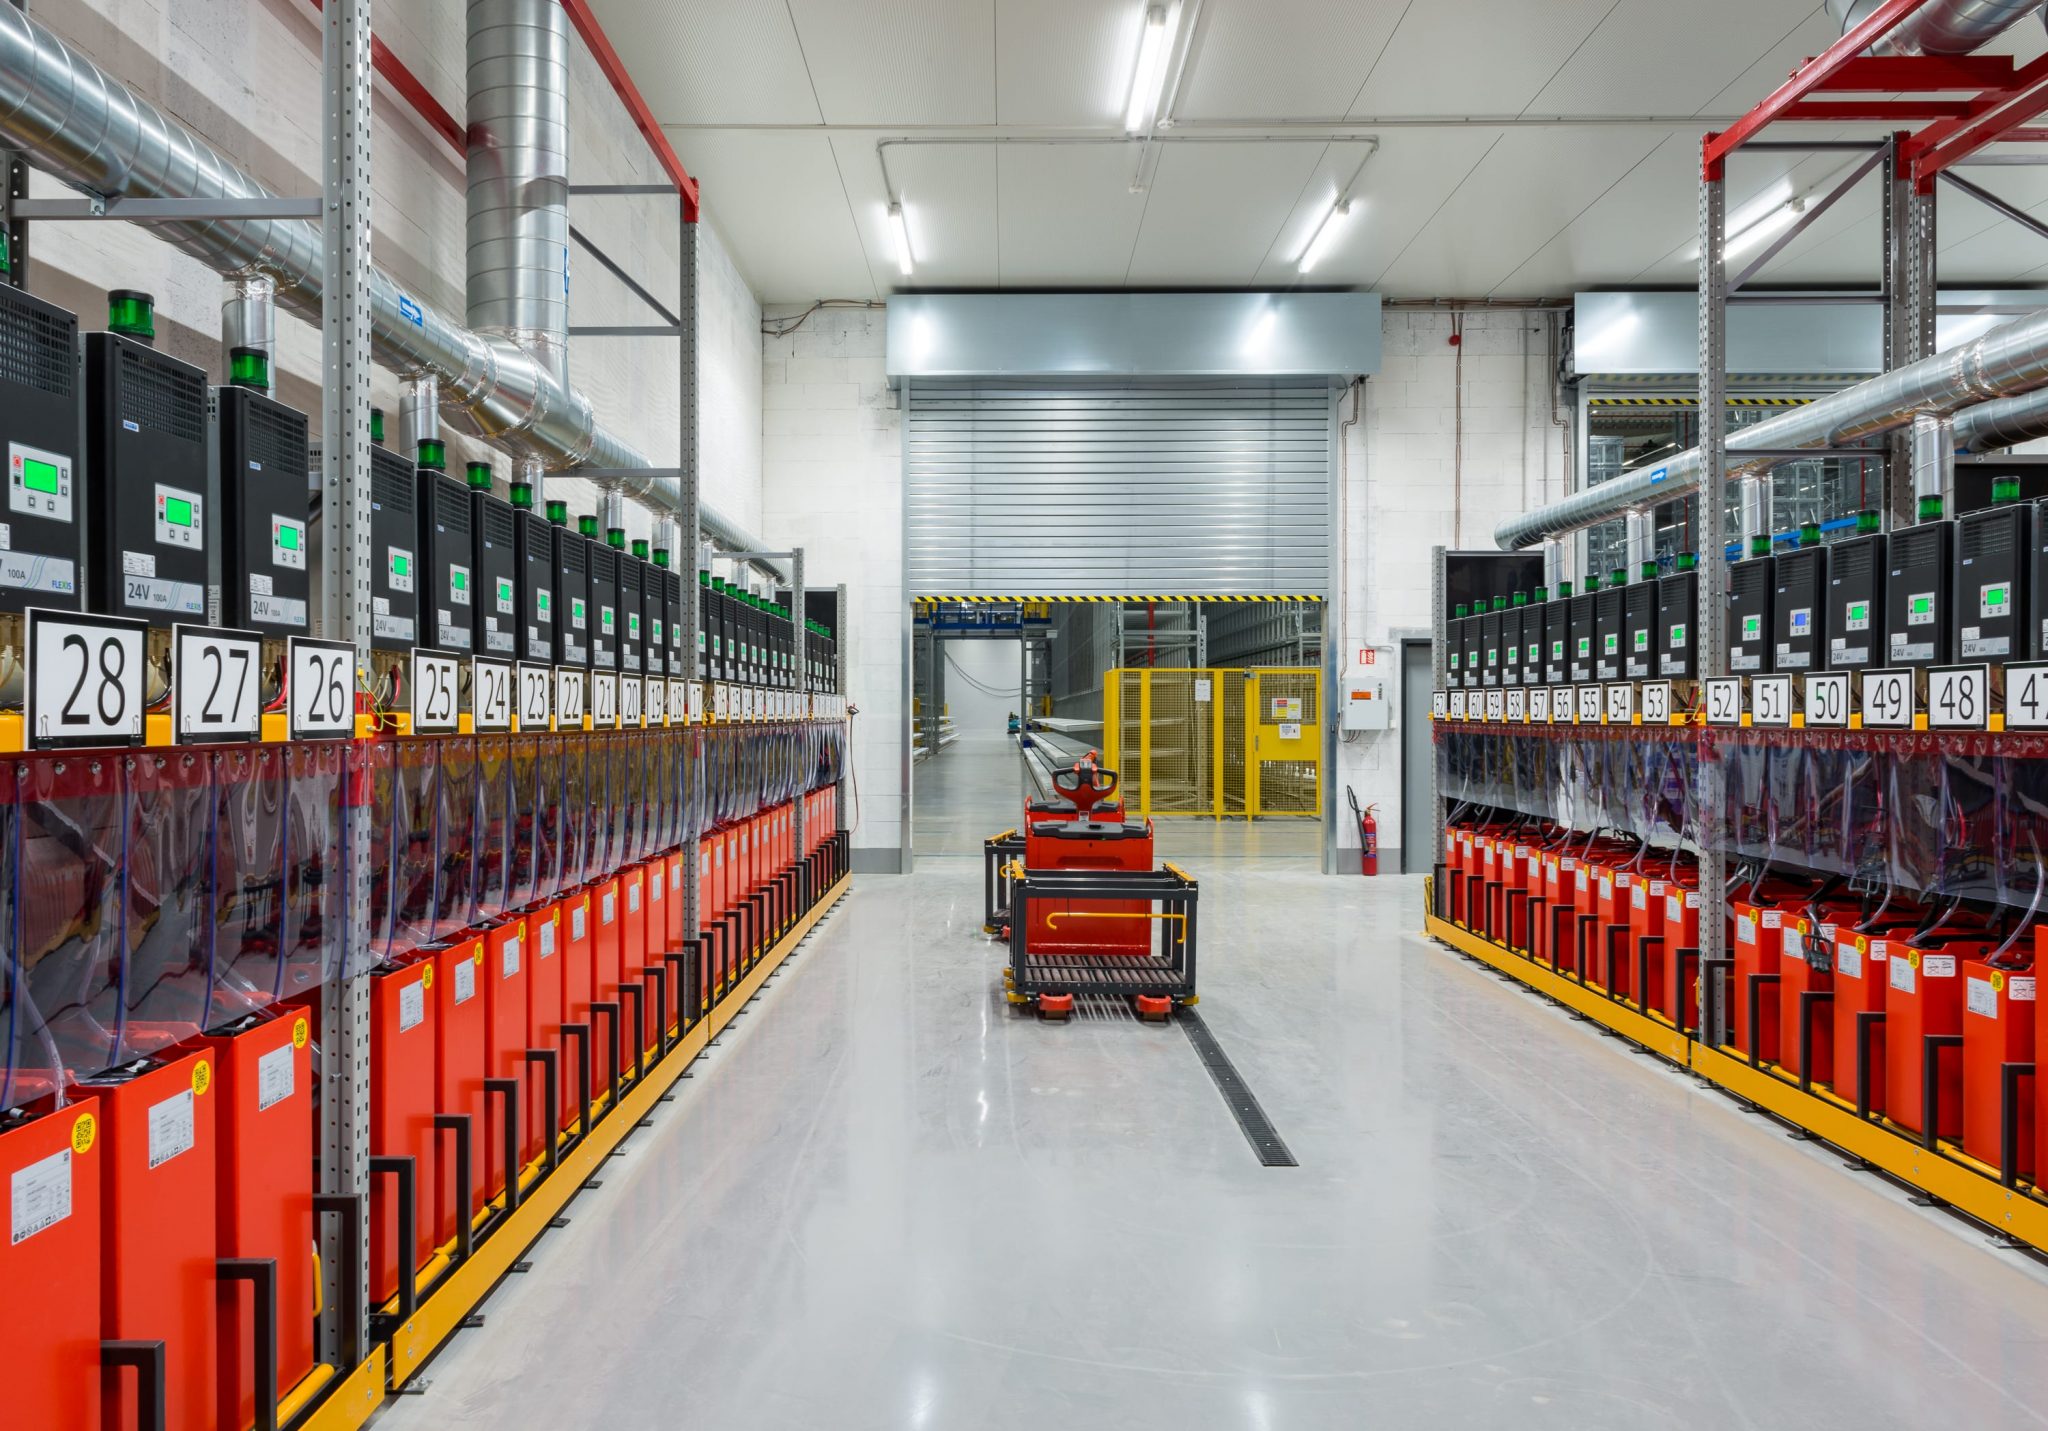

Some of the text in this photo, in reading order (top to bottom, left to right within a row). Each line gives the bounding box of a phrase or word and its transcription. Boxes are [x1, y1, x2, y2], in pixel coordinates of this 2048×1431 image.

[8, 568, 72, 590] 100A FLEXIS
[128, 582, 201, 611] 24V 100A FLEXIS
[253, 600, 269, 616] 24V
[375, 618, 387, 632] 24V
[440, 628, 450, 641] 24V
[1832, 652, 1843, 662] 24V
[1892, 648, 1905, 658] 24V
[1963, 643, 1977, 654] 24V
[61, 633, 126, 726] 28
[201, 645, 249, 724] 27
[308, 654, 345, 723] 26
[425, 663, 451, 721] 25
[485, 669, 505, 720] 24
[528, 672, 545, 720] 23
[564, 676, 579, 719] 22
[599, 679, 612, 719] 21
[626, 682, 638, 720] 20
[651, 684, 661, 719] 19
[673, 686, 682, 719] 18
[693, 687, 701, 718] 17
[1436, 695, 1444, 716] 62
[1454, 694, 1461, 716] 61
[1472, 694, 1480, 717] 60
[1490, 694, 1499, 717] 59
[1510, 693, 1520, 717] 58
[1534, 693, 1545, 718] 57
[1557, 691, 1569, 718] 56
[1584, 691, 1597, 718] 55
[1613, 689, 1627, 718] 54
[1648, 687, 1663, 718] 53
[1712, 684, 1732, 718] 52
[1760, 683, 1781, 718] 51
[1814, 680, 1839, 719] 50
[1872, 678, 1901, 720] 49
[1940, 675, 1974, 720] 48
